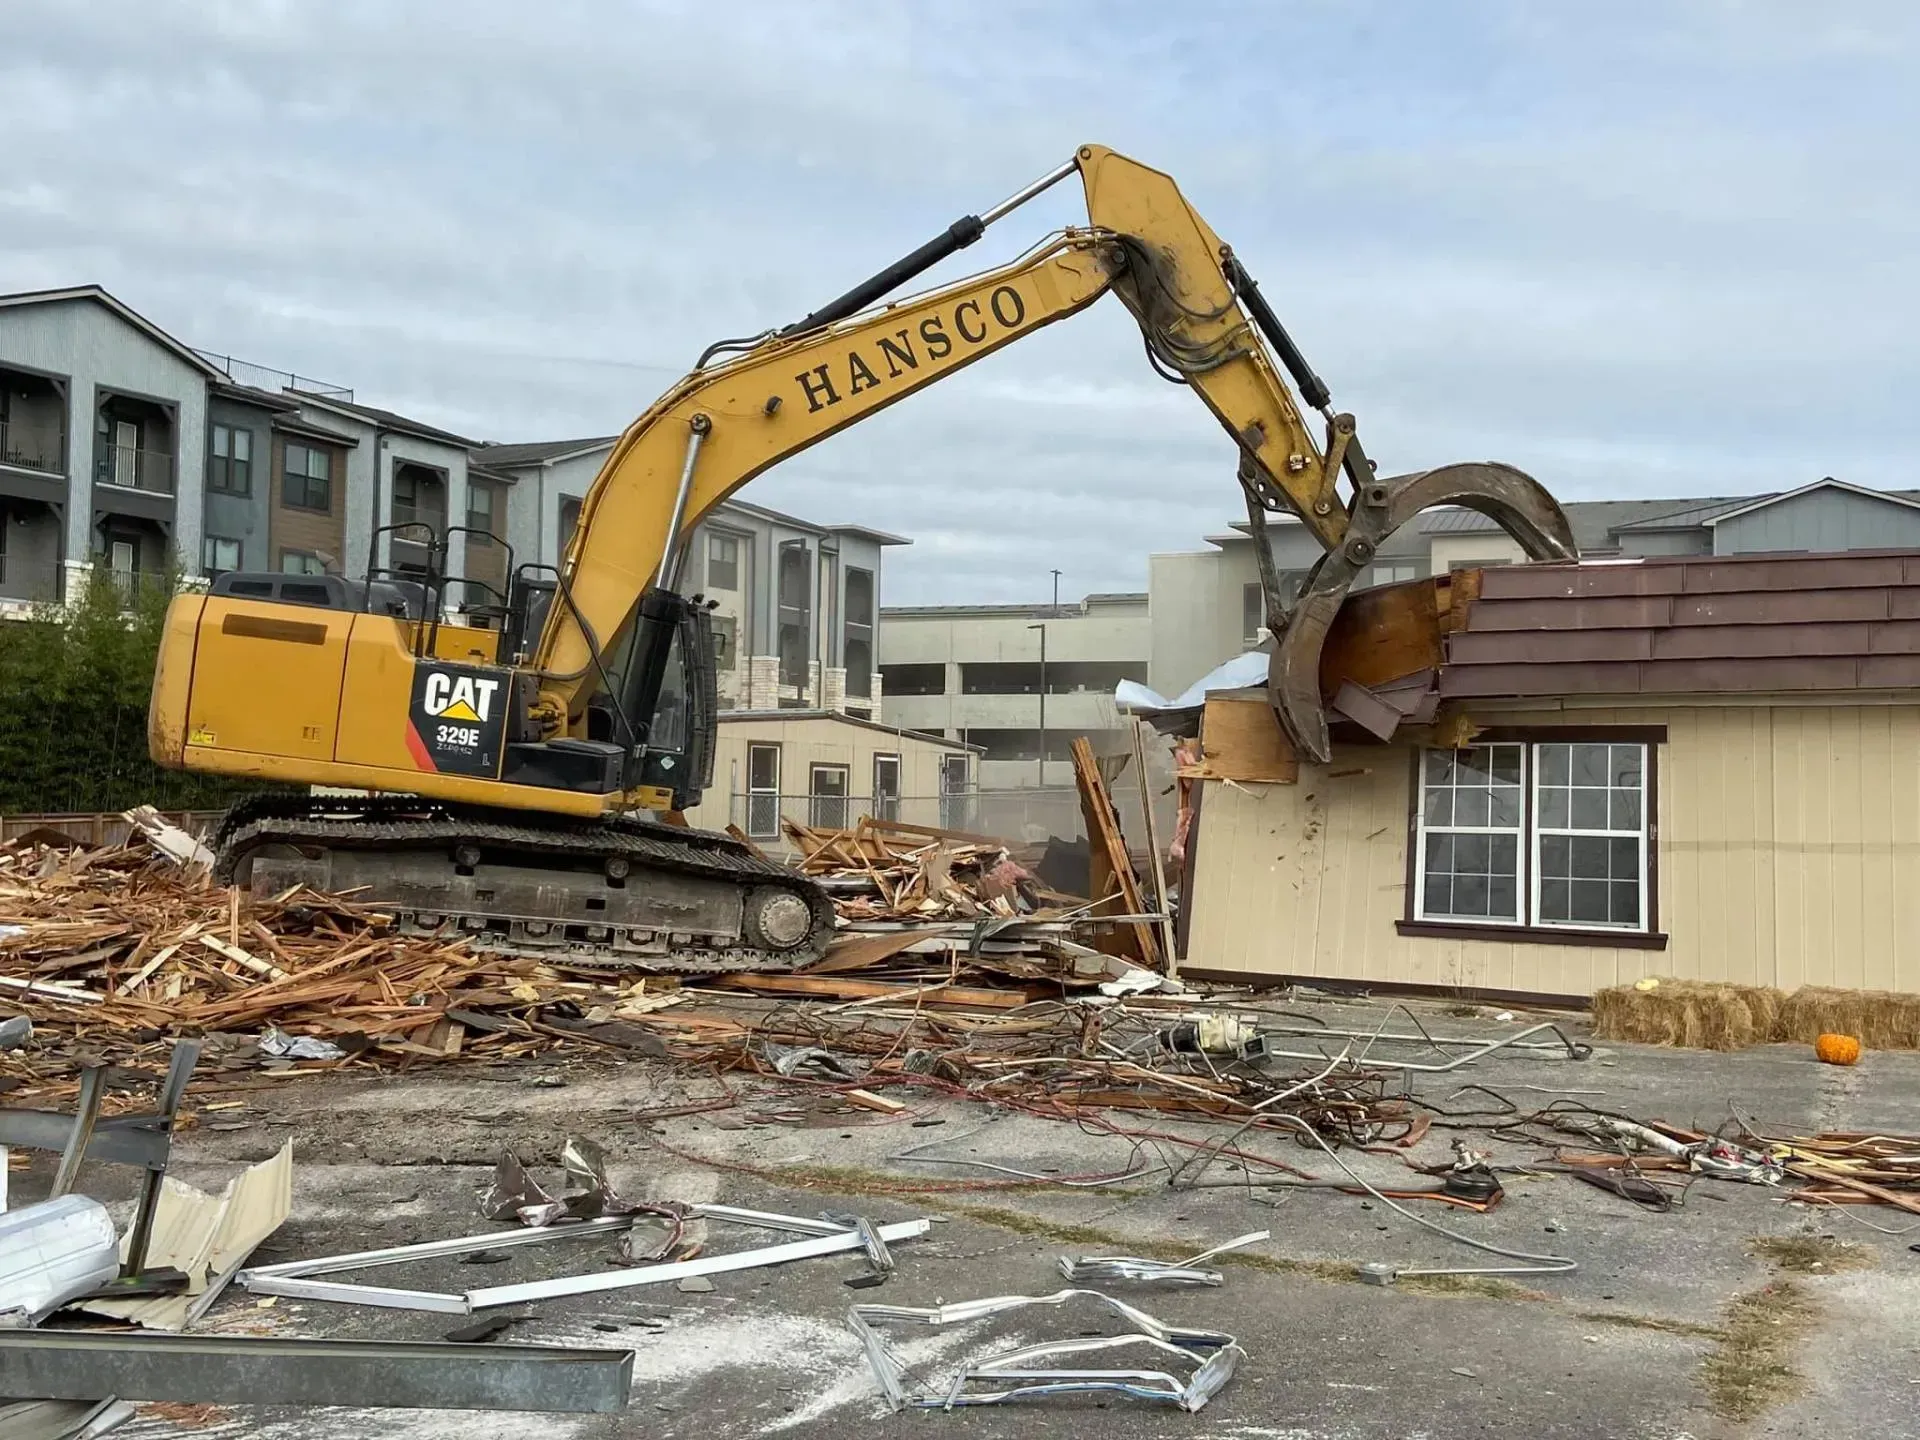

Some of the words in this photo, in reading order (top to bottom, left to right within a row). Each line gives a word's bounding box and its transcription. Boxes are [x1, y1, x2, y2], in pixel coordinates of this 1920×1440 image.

[795, 286, 1025, 413] HANSCO
[424, 672, 499, 722] CAT
[436, 724, 480, 747] 329E
